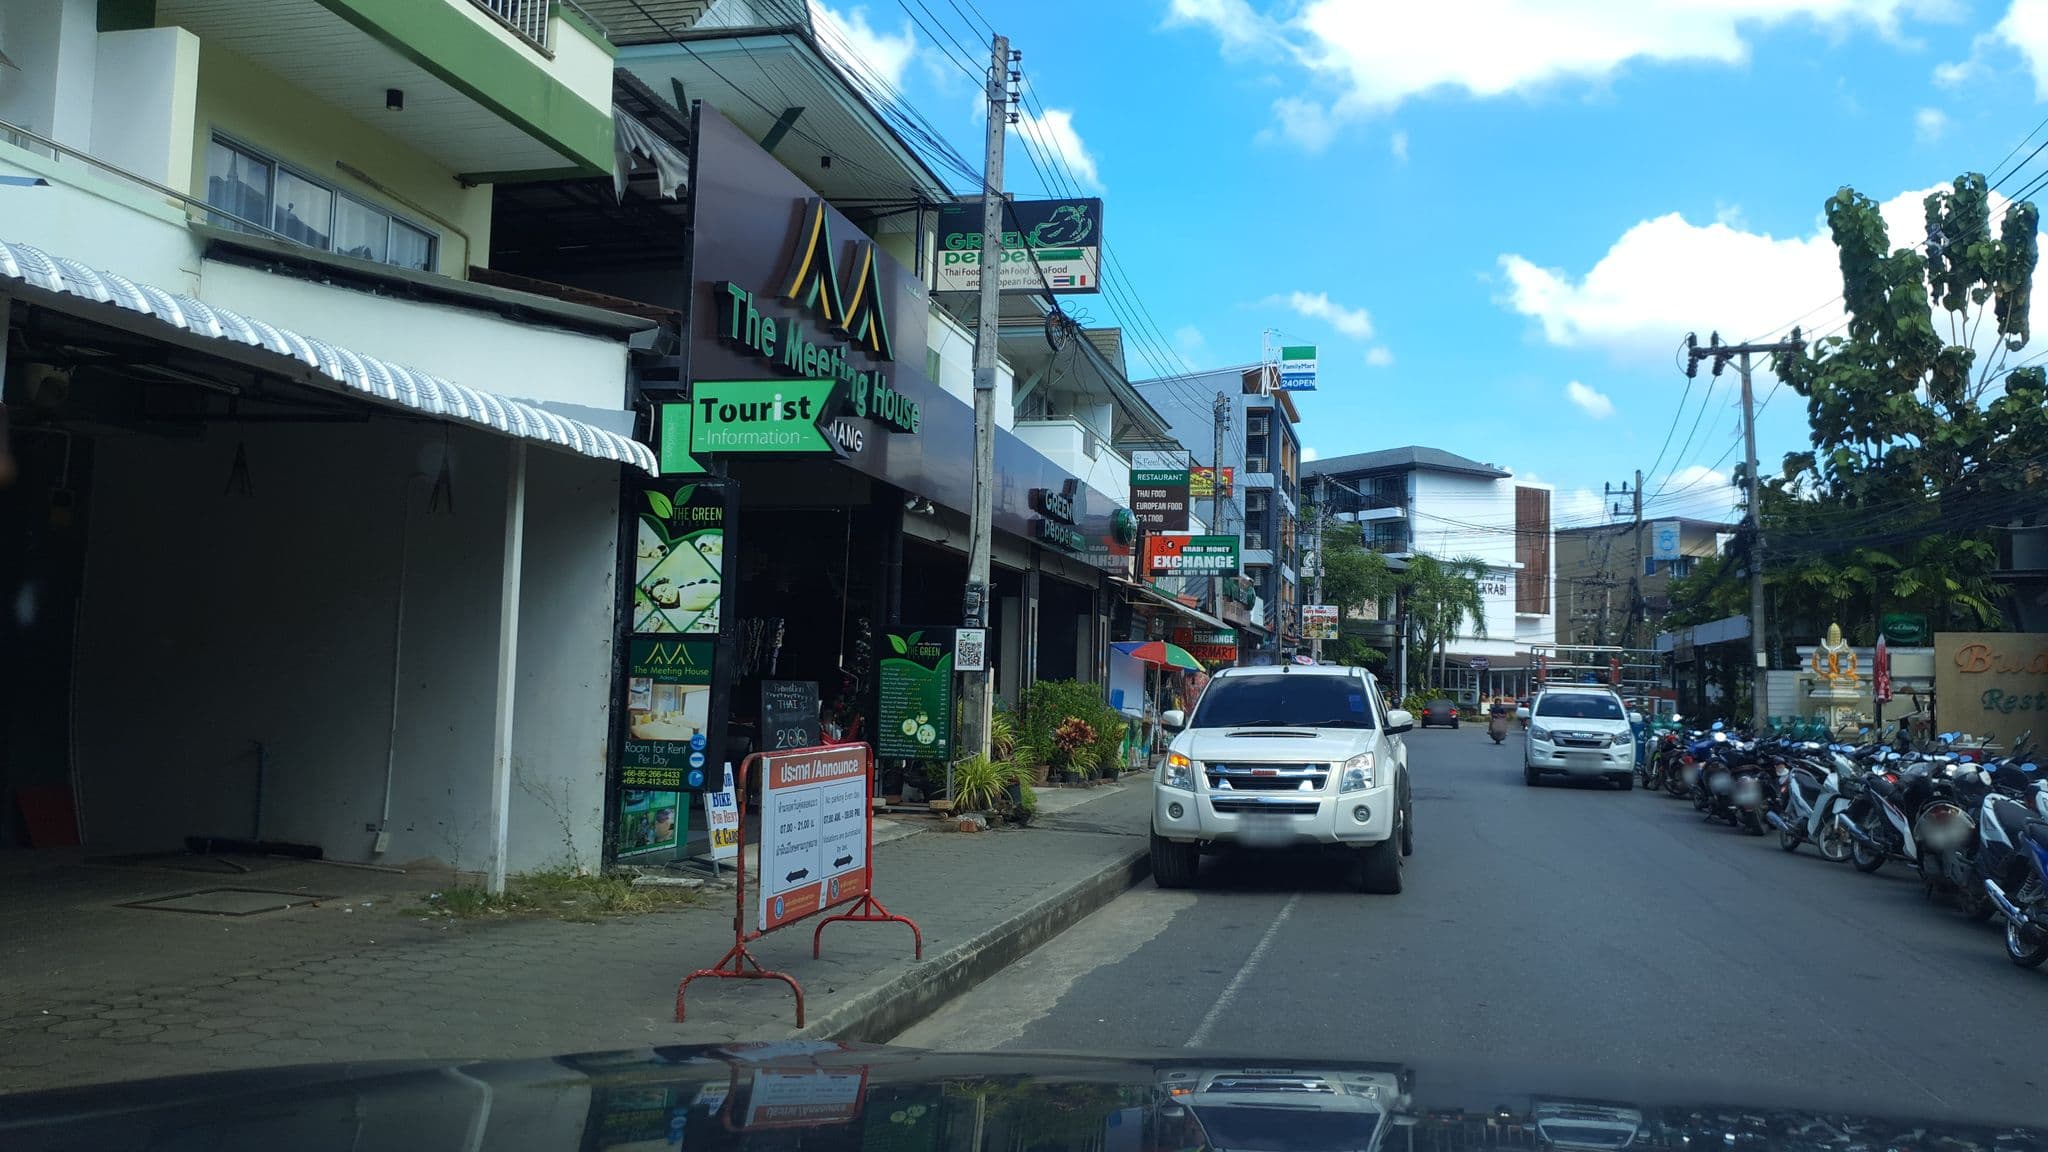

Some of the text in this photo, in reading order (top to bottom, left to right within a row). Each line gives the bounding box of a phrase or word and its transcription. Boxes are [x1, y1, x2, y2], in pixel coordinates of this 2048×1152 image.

[945, 231, 1041, 250] GREN
[726, 283, 920, 435] The Meeting House
[699, 393, 811, 423] Tourist
[1137, 473, 1183, 481] RESTAURANT
[1136, 489, 1167, 498] THAI FOOD
[1136, 502, 1183, 511] EUROPEAN FOOD
[673, 506, 722, 521] THE GREEN
[1153, 555, 1235, 568] EXCHANGE
[1194, 634, 1234, 644] EXCHANGE
[919, 646, 940, 657] GREEN
[634, 665, 709, 677] The Meeting House
[625, 741, 687, 754] Room for Rent
[638, 753, 670, 767] Per Day
[712, 792, 732, 807] BIKE
